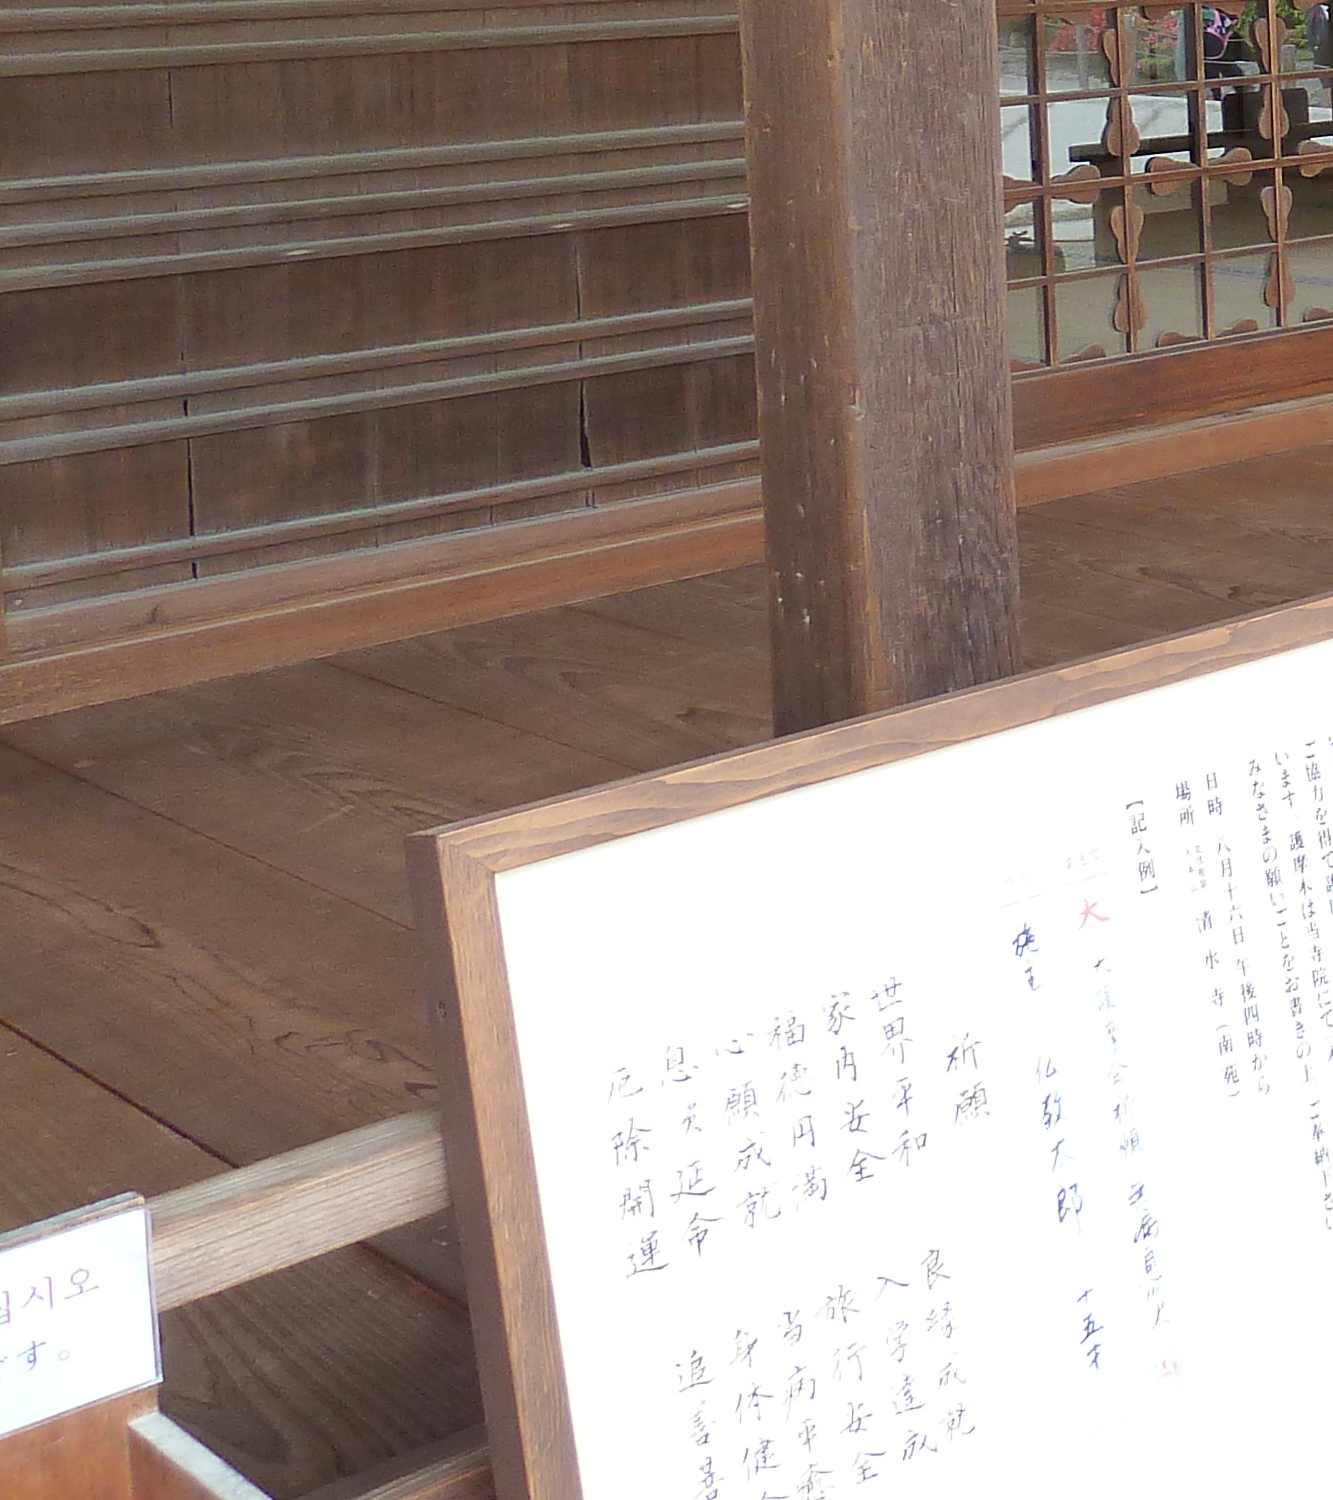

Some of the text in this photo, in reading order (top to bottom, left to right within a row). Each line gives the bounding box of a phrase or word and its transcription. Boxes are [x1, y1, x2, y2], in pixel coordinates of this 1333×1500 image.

[1175, 780, 1194, 825] 場所
[1205, 771, 1223, 815] 日時
[715, 1032, 781, 1228] 心願成就
[768, 1010, 827, 1211] 福徳円満
[822, 991, 887, 1182] 家内安全
[869, 976, 928, 1166] 世界平和
[946, 1032, 990, 1121] 祈願
[609, 1067, 669, 1278] 厄除開運
[825, 1284, 886, 1484] 旅行安全
[876, 1275, 938, 1461] 入学達成
[920, 1248, 976, 1440] 良縁成就
